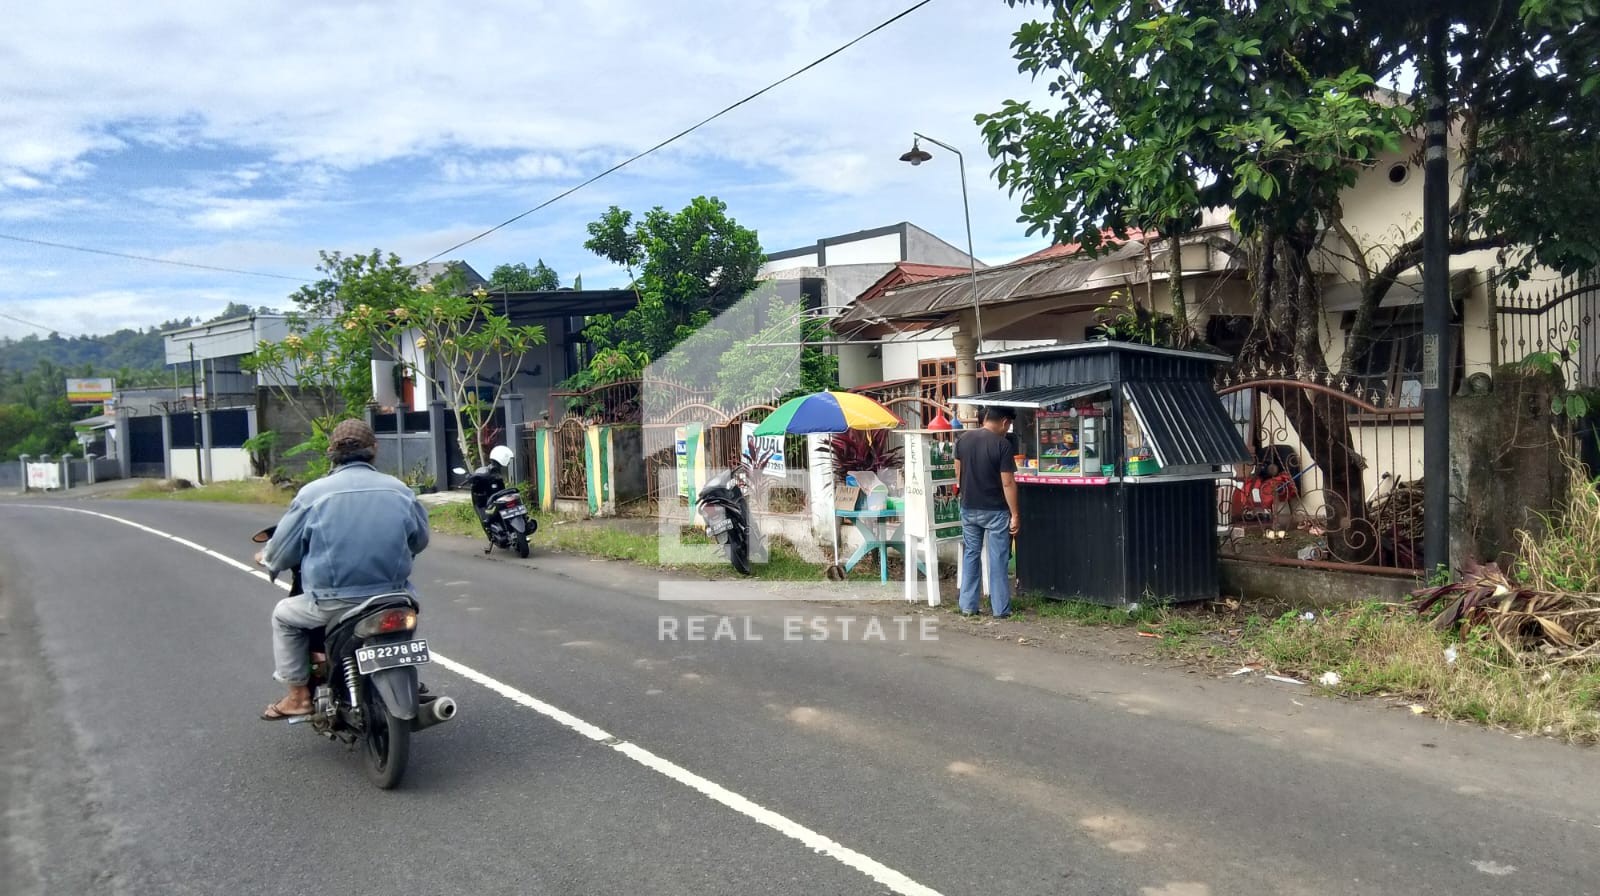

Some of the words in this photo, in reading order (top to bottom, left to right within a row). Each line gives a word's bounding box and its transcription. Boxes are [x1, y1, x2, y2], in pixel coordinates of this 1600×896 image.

[359, 649, 375, 662] DB
[377, 645, 408, 658] 2278
[410, 642, 426, 653] BF
